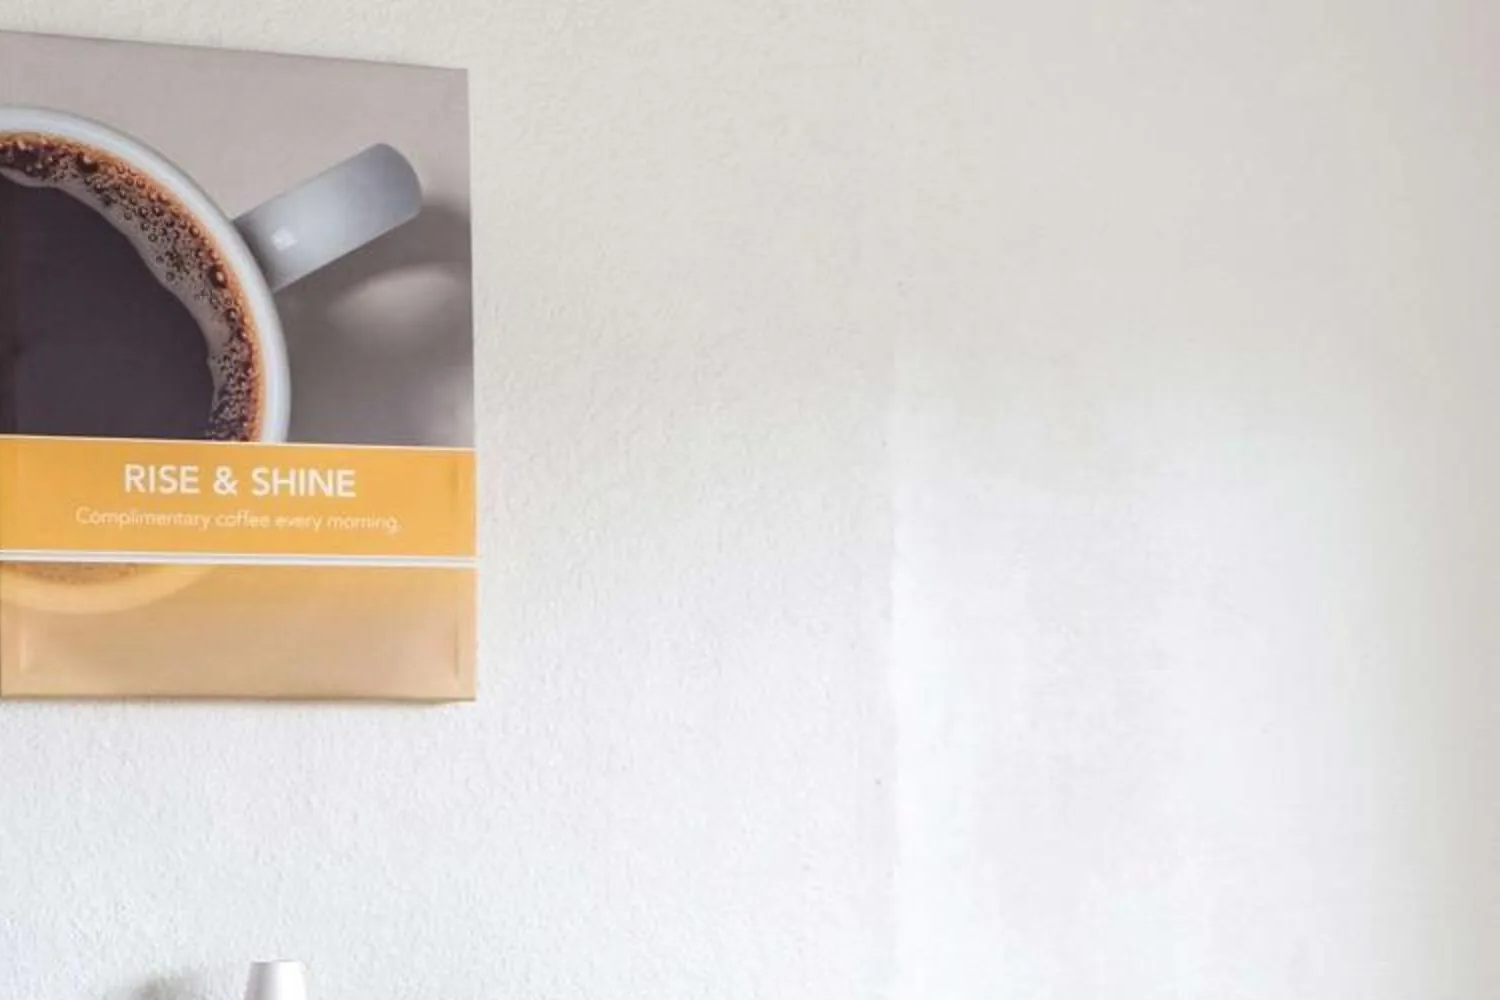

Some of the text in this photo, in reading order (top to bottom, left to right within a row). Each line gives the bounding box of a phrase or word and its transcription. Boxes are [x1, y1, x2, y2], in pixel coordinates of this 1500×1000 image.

[124, 463, 356, 498] RISE & SHINE
[75, 506, 211, 530] Complimentary
[215, 509, 271, 529] coffee
[275, 514, 323, 533] every
